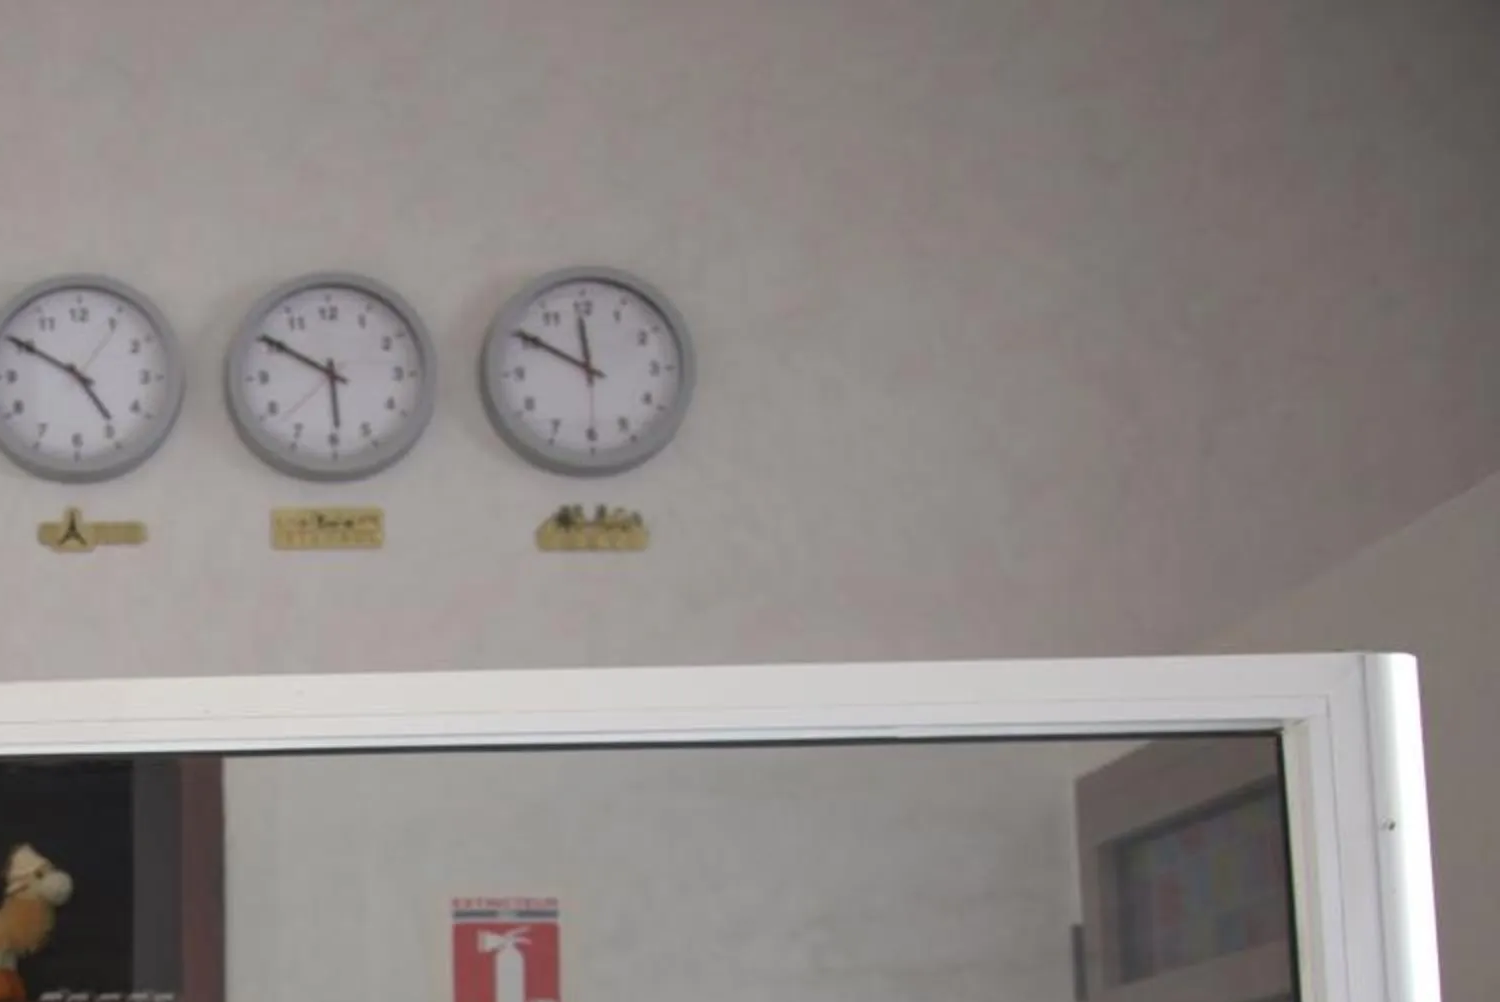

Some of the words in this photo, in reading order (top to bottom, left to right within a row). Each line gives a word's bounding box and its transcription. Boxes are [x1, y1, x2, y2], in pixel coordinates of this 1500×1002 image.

[69, 307, 89, 322] 12
[319, 306, 338, 320] 12
[573, 300, 593, 316] 12
[289, 316, 305, 330] 11
[358, 314, 366, 329] 1
[543, 312, 560, 326] 11
[613, 310, 621, 323] 1
[39, 317, 55, 331] 11
[109, 317, 116, 331] 1
[38, 423, 47, 437] 7
[294, 422, 304, 438] 7
[552, 418, 561, 434] 7
